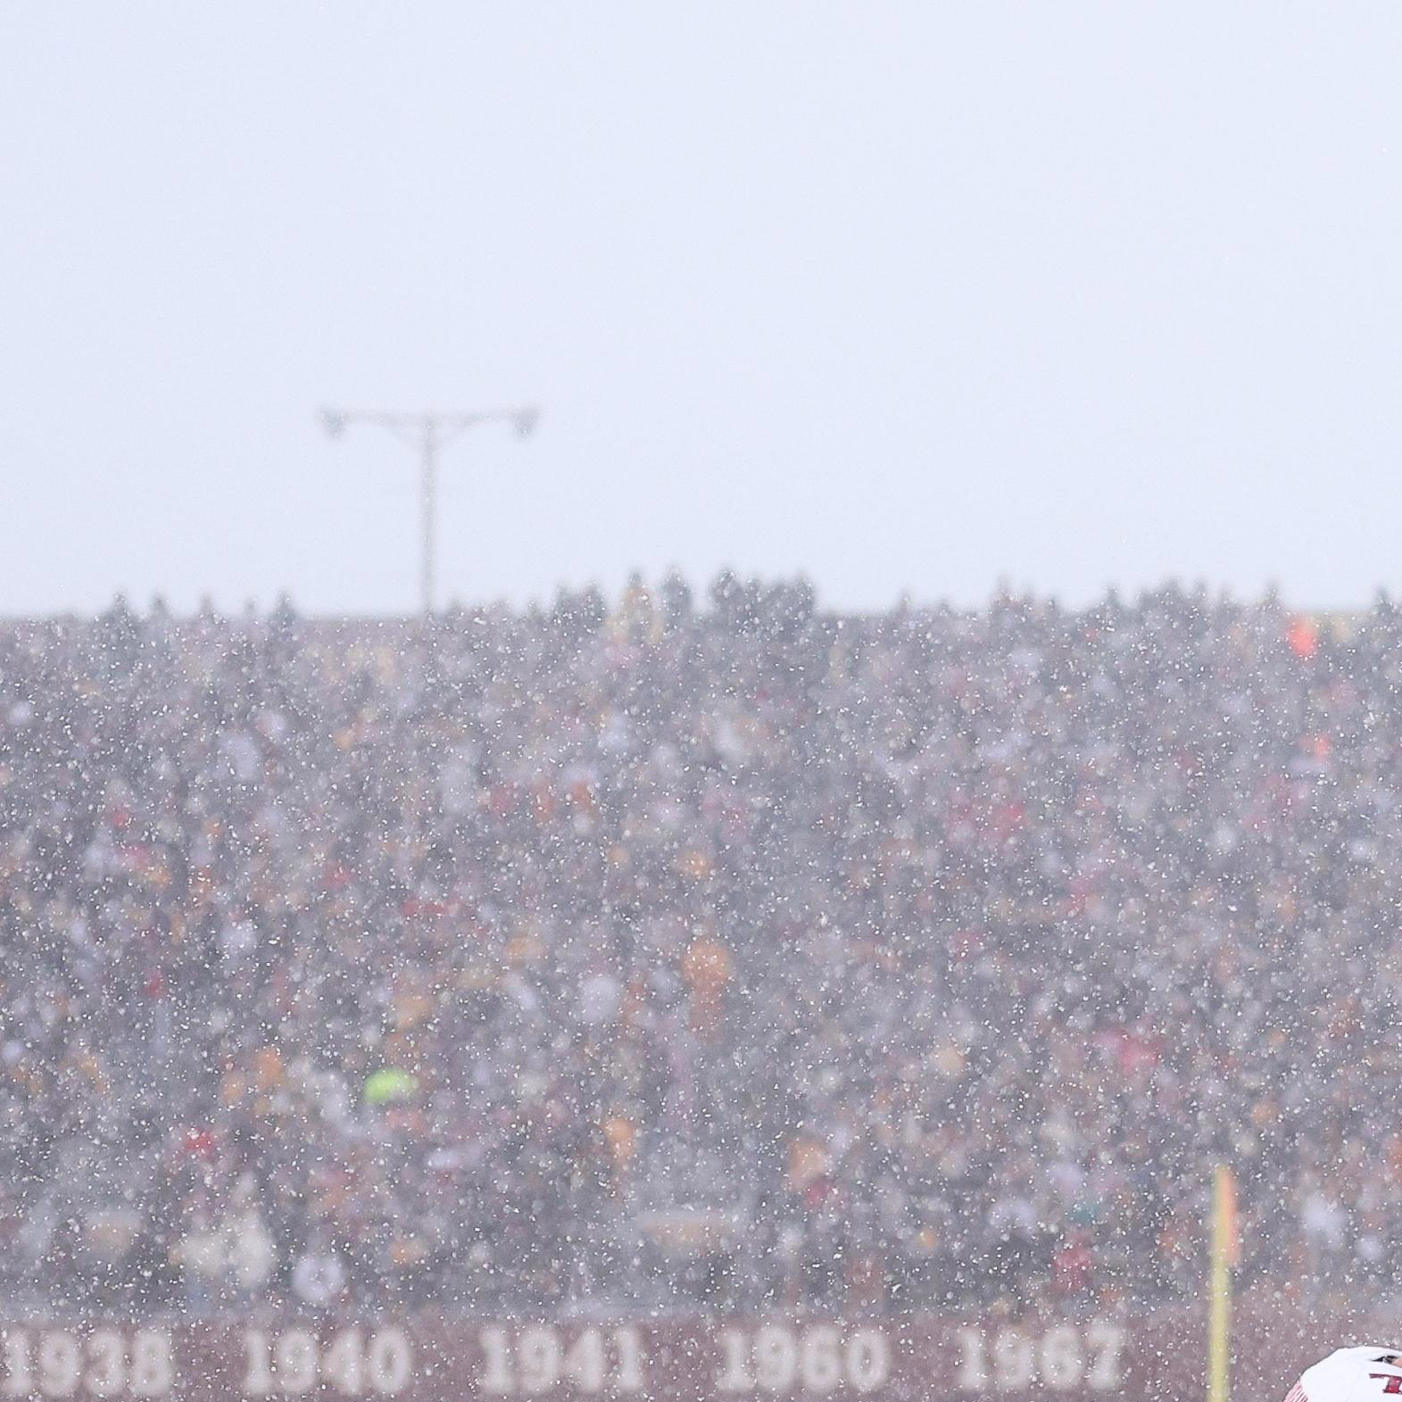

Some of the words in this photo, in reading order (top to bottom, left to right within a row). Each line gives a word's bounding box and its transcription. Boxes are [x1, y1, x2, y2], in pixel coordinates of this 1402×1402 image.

[4, 1328, 173, 1396] 1938
[243, 1326, 408, 1394] 1940
[480, 1326, 642, 1391] 1941
[717, 1326, 888, 1391] 1960
[957, 1324, 1124, 1391] 1967
